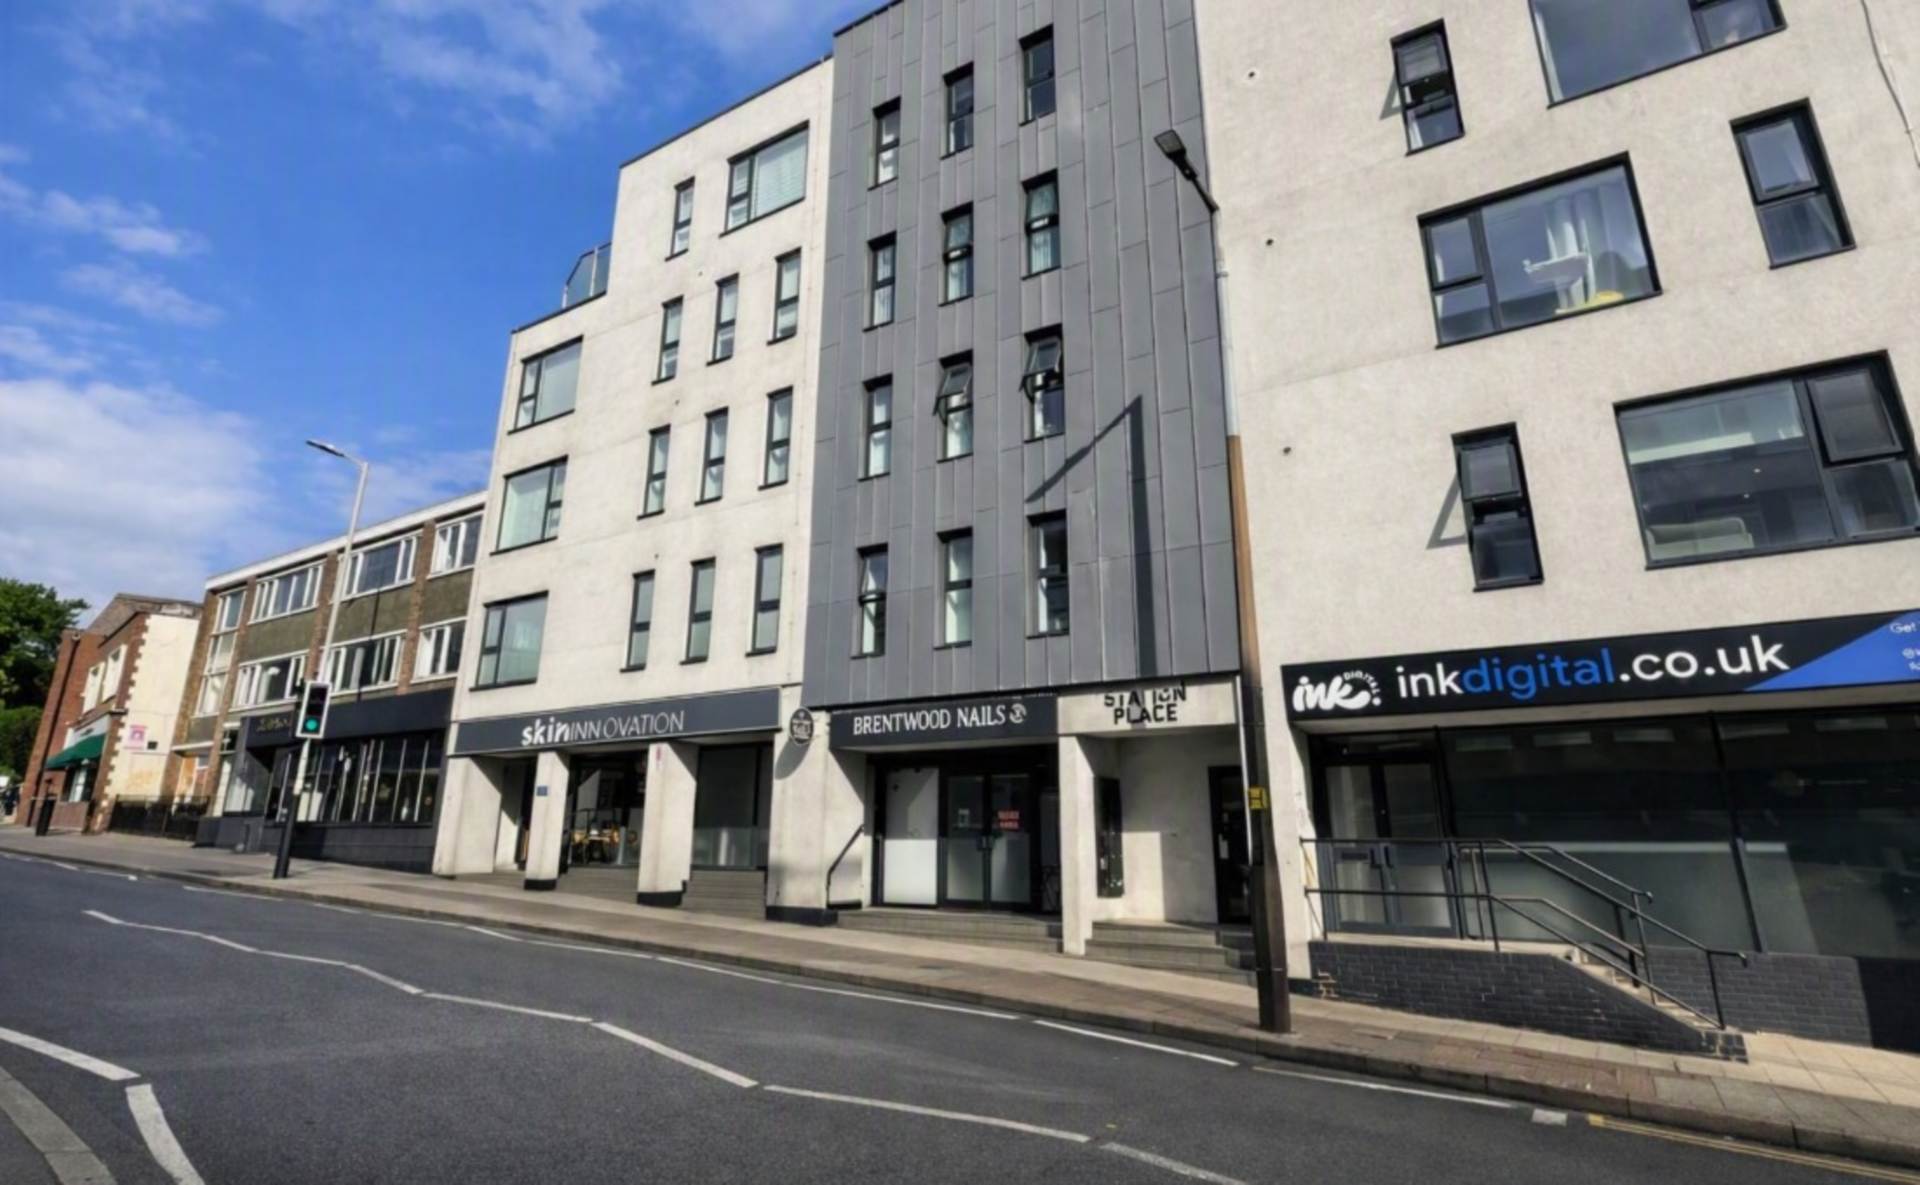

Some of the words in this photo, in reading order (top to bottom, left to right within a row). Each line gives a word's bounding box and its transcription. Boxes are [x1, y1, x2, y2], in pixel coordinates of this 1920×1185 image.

[1396, 635, 1790, 700] inkdigital.co.uk
[852, 709, 951, 736] BRENTWOOD
[956, 704, 1006, 729] NAILS
[1113, 703, 1178, 725] PLACE
